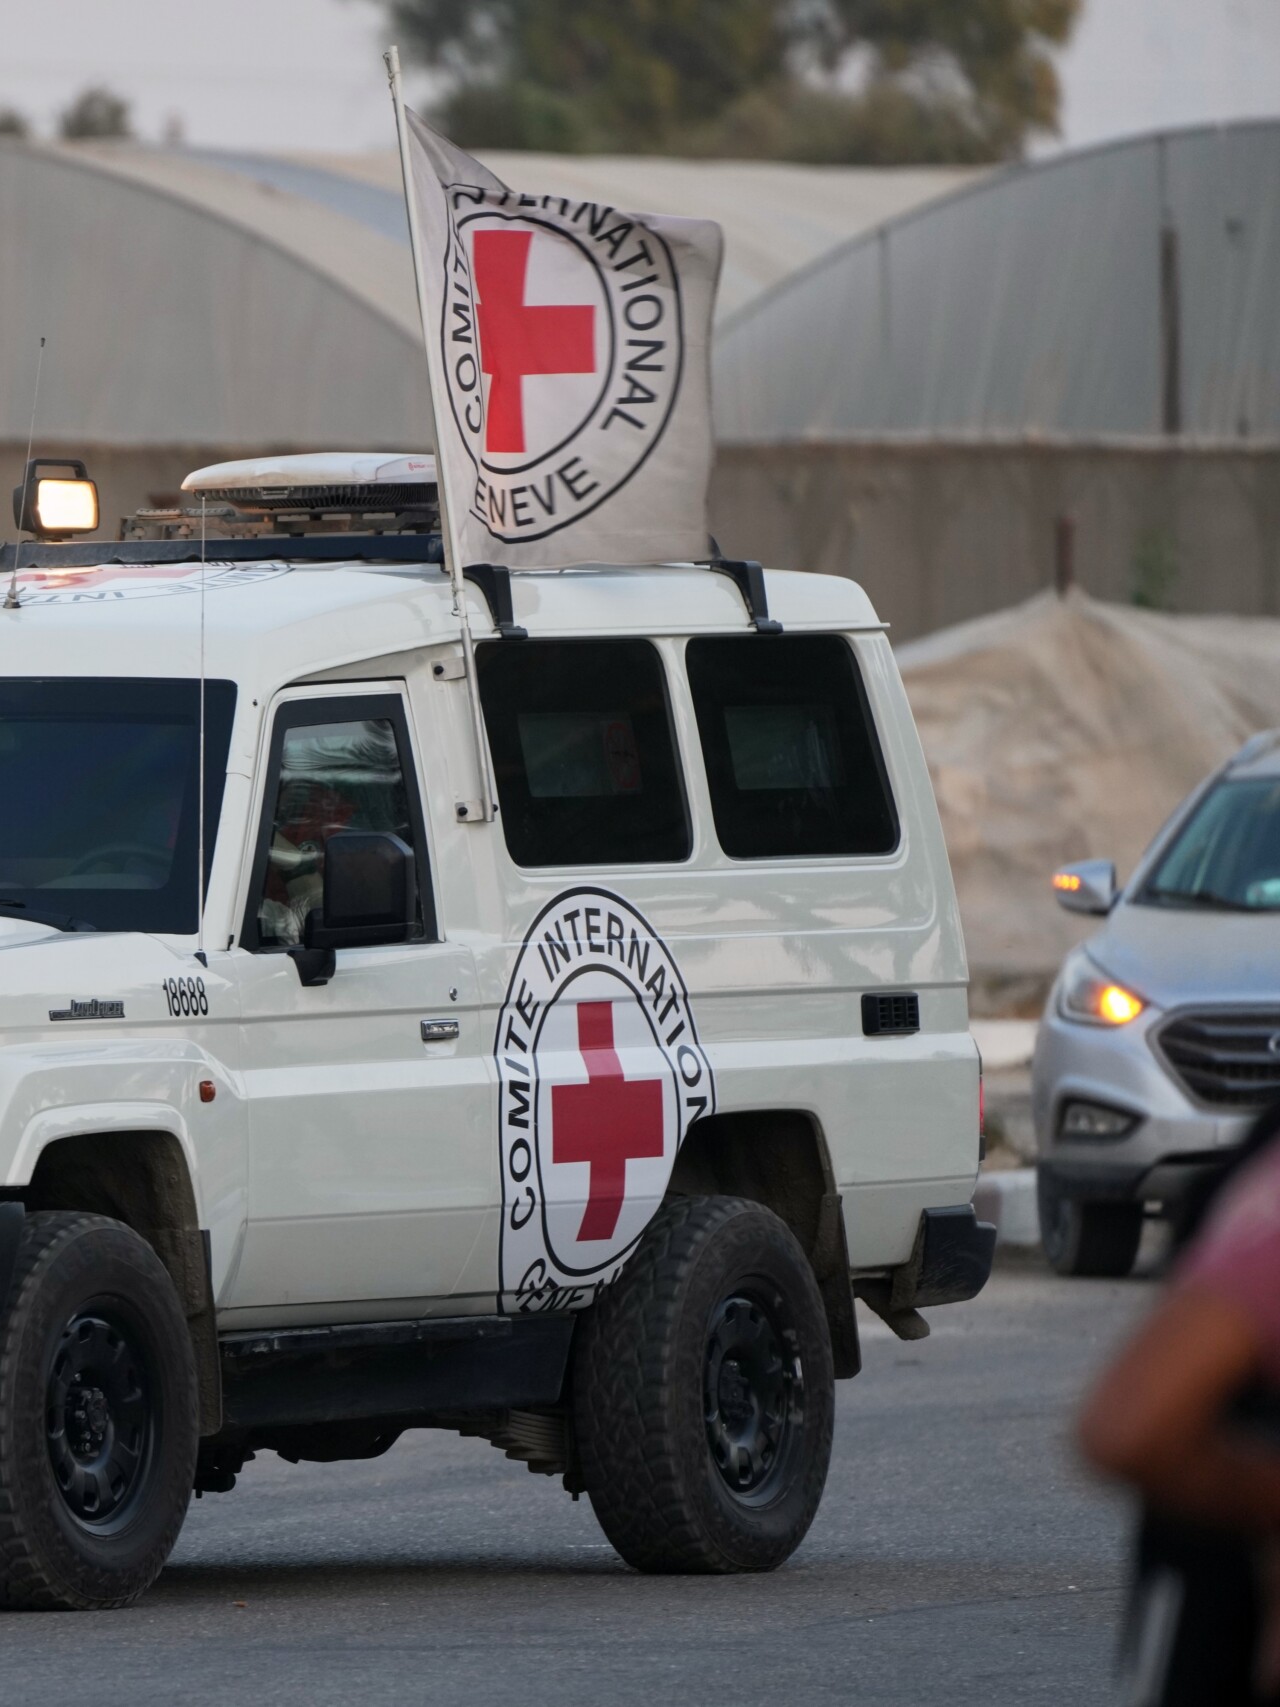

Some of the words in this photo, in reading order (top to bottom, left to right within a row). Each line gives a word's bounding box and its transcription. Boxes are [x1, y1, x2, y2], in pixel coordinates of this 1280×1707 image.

[451, 228, 482, 434] COMIT
[475, 456, 600, 528] ENEVE
[162, 975, 209, 1017] 18688
[504, 977, 541, 1231] COMITE
[537, 907, 708, 1130] INTERNATION
